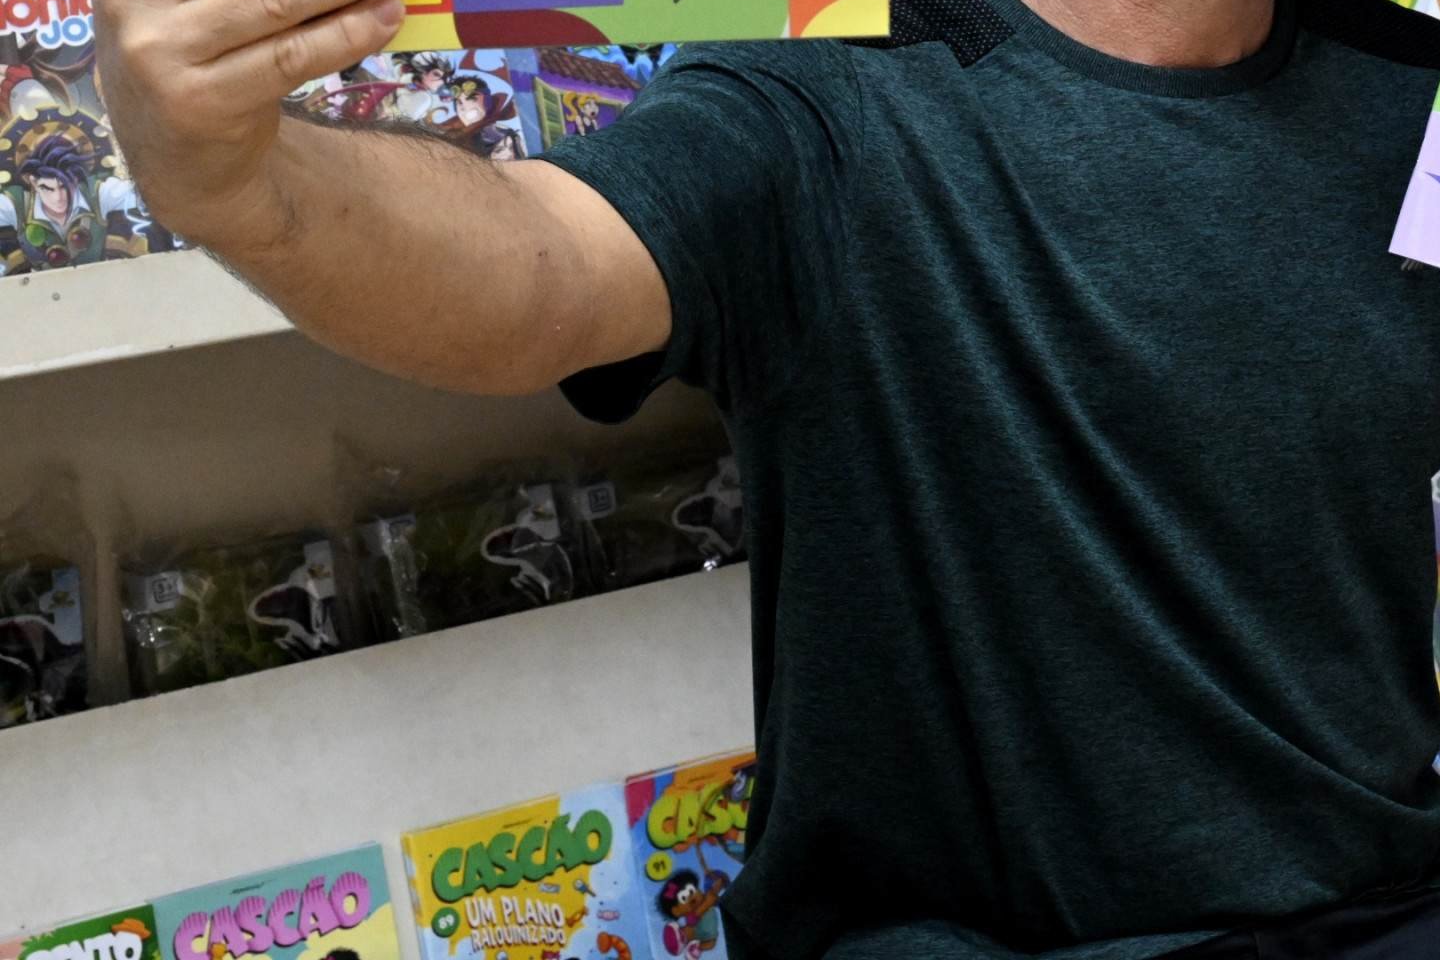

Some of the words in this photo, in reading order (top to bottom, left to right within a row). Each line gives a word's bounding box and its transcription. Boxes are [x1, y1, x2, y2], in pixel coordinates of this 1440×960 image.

[431, 809, 613, 903] CASCÃO
[173, 871, 371, 960] CASCÃO
[465, 896, 497, 927] UM
[501, 897, 565, 929] PLANO
